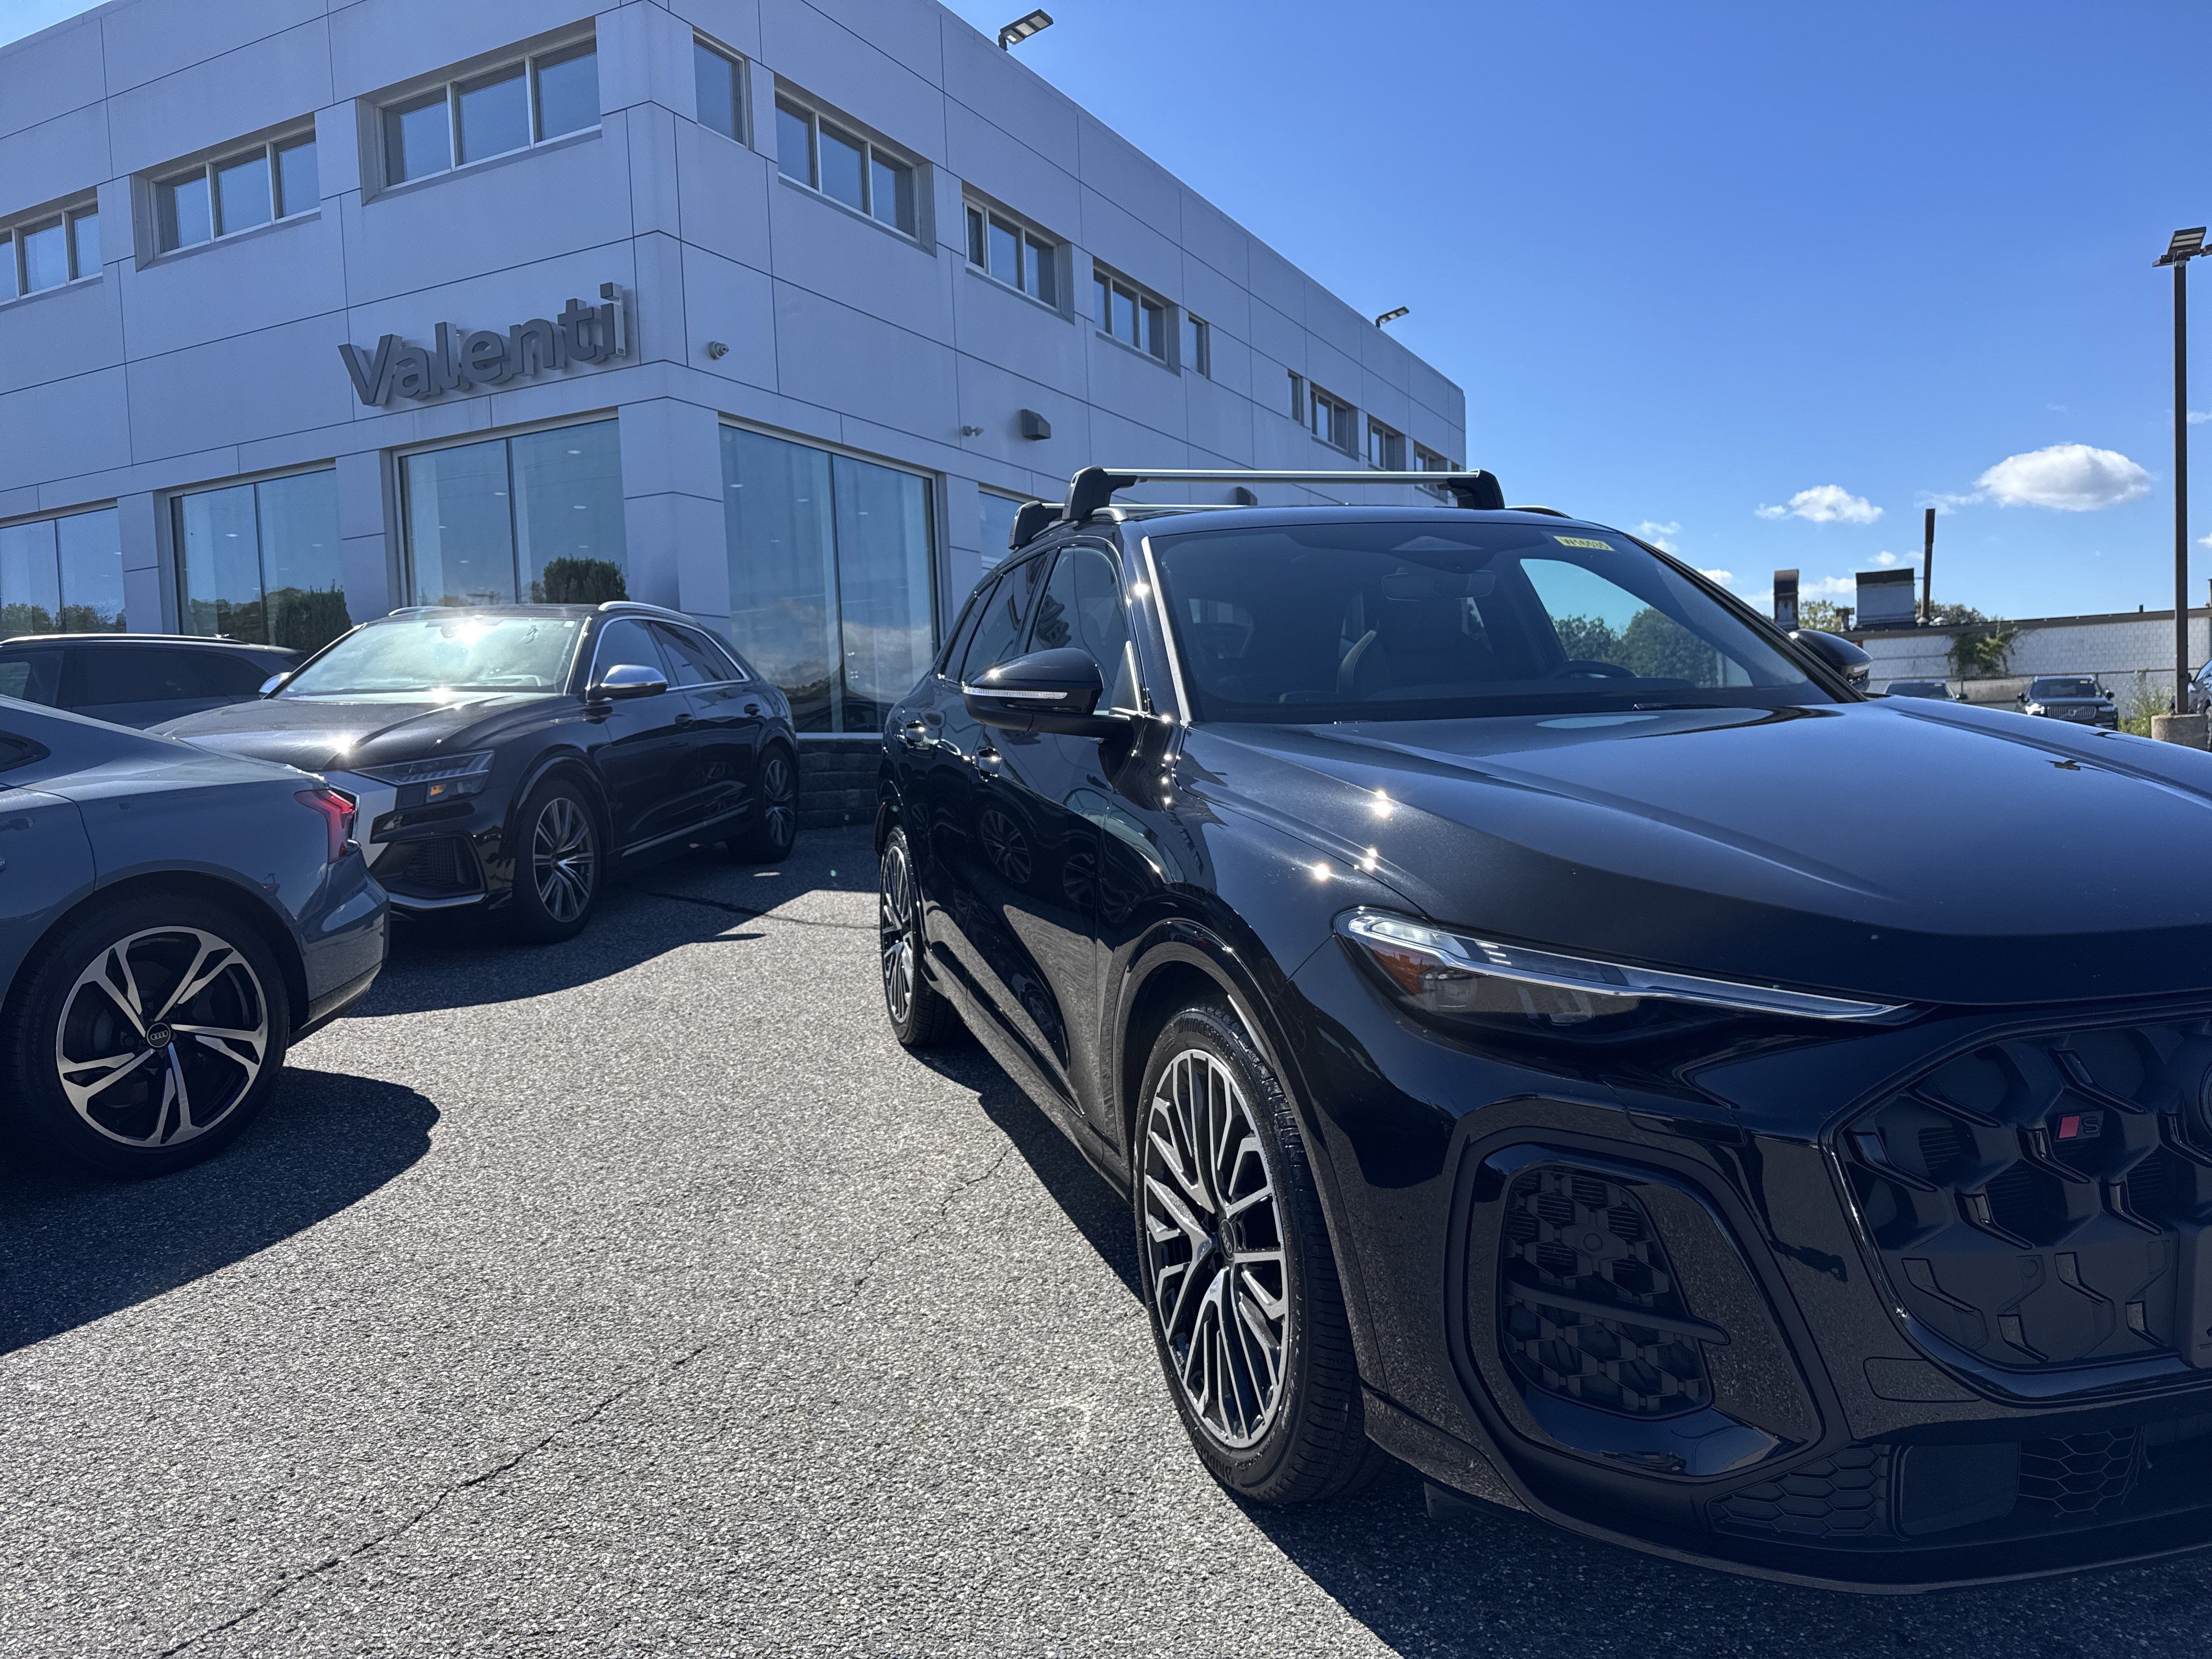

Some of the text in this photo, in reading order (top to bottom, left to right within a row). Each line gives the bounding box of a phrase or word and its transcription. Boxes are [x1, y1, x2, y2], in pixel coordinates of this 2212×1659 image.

[338, 282, 625, 406] Valenti
[1178, 1017, 1236, 1062] BRIDGESTONE
[2081, 1116, 2100, 1135] S
